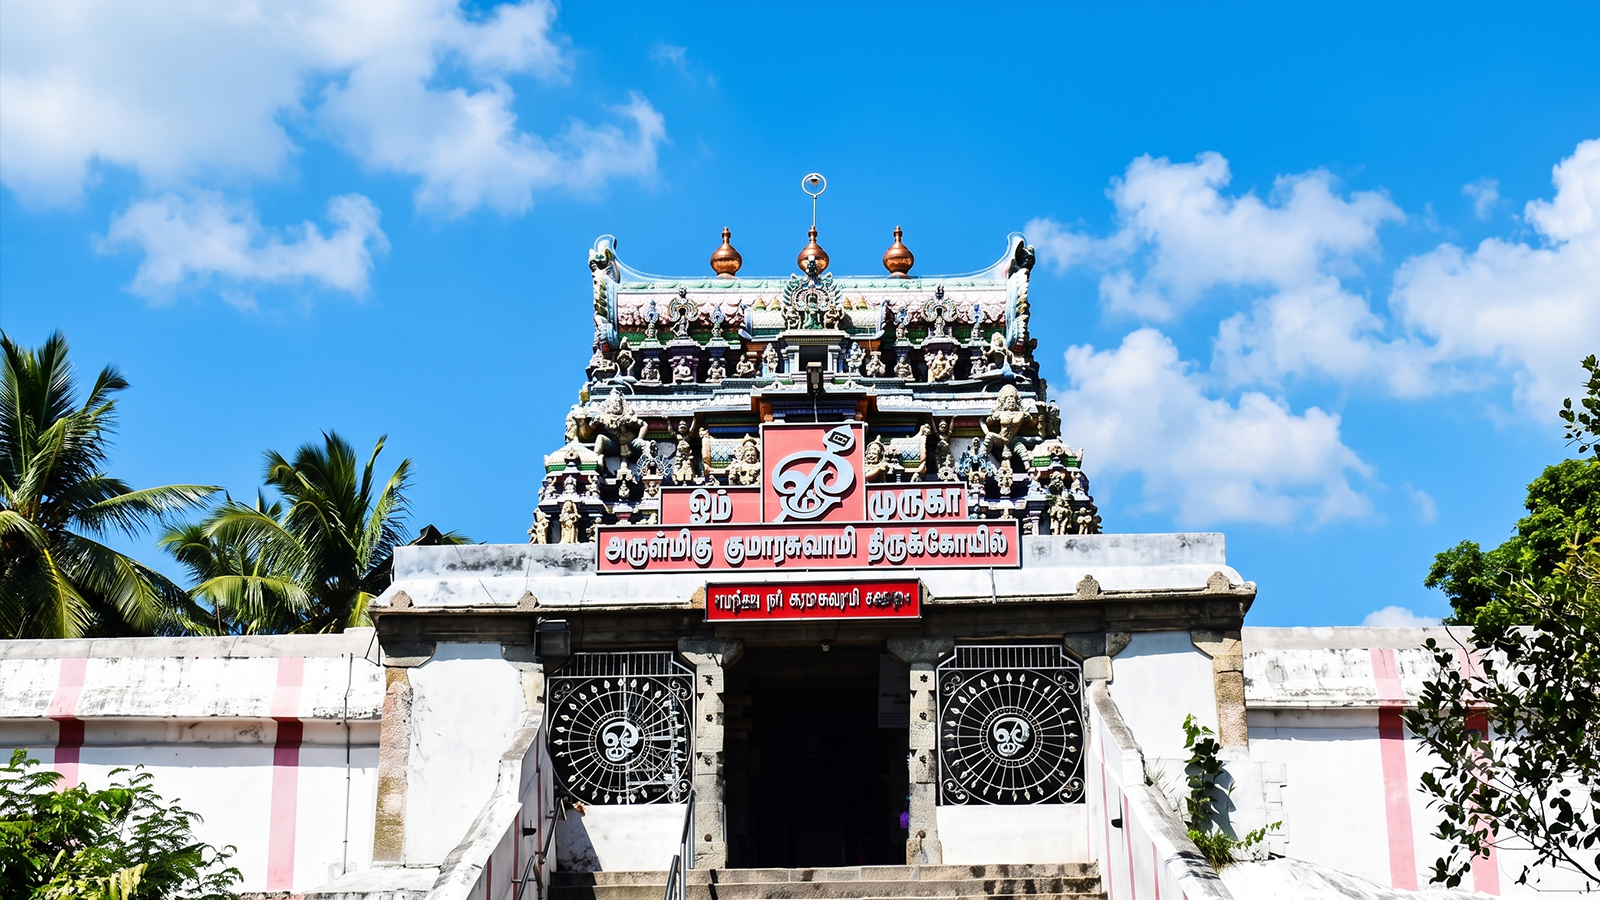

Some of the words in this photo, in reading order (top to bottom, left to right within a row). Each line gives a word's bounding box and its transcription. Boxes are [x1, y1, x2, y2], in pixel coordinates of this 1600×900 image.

[689, 488, 732, 525] ஓம்
[869, 487, 961, 522] முருகா
[605, 528, 713, 567] அருள்மிகு
[724, 525, 857, 565] குமாரசுவாமி
[867, 524, 1008, 563] திருக்கோயில்
